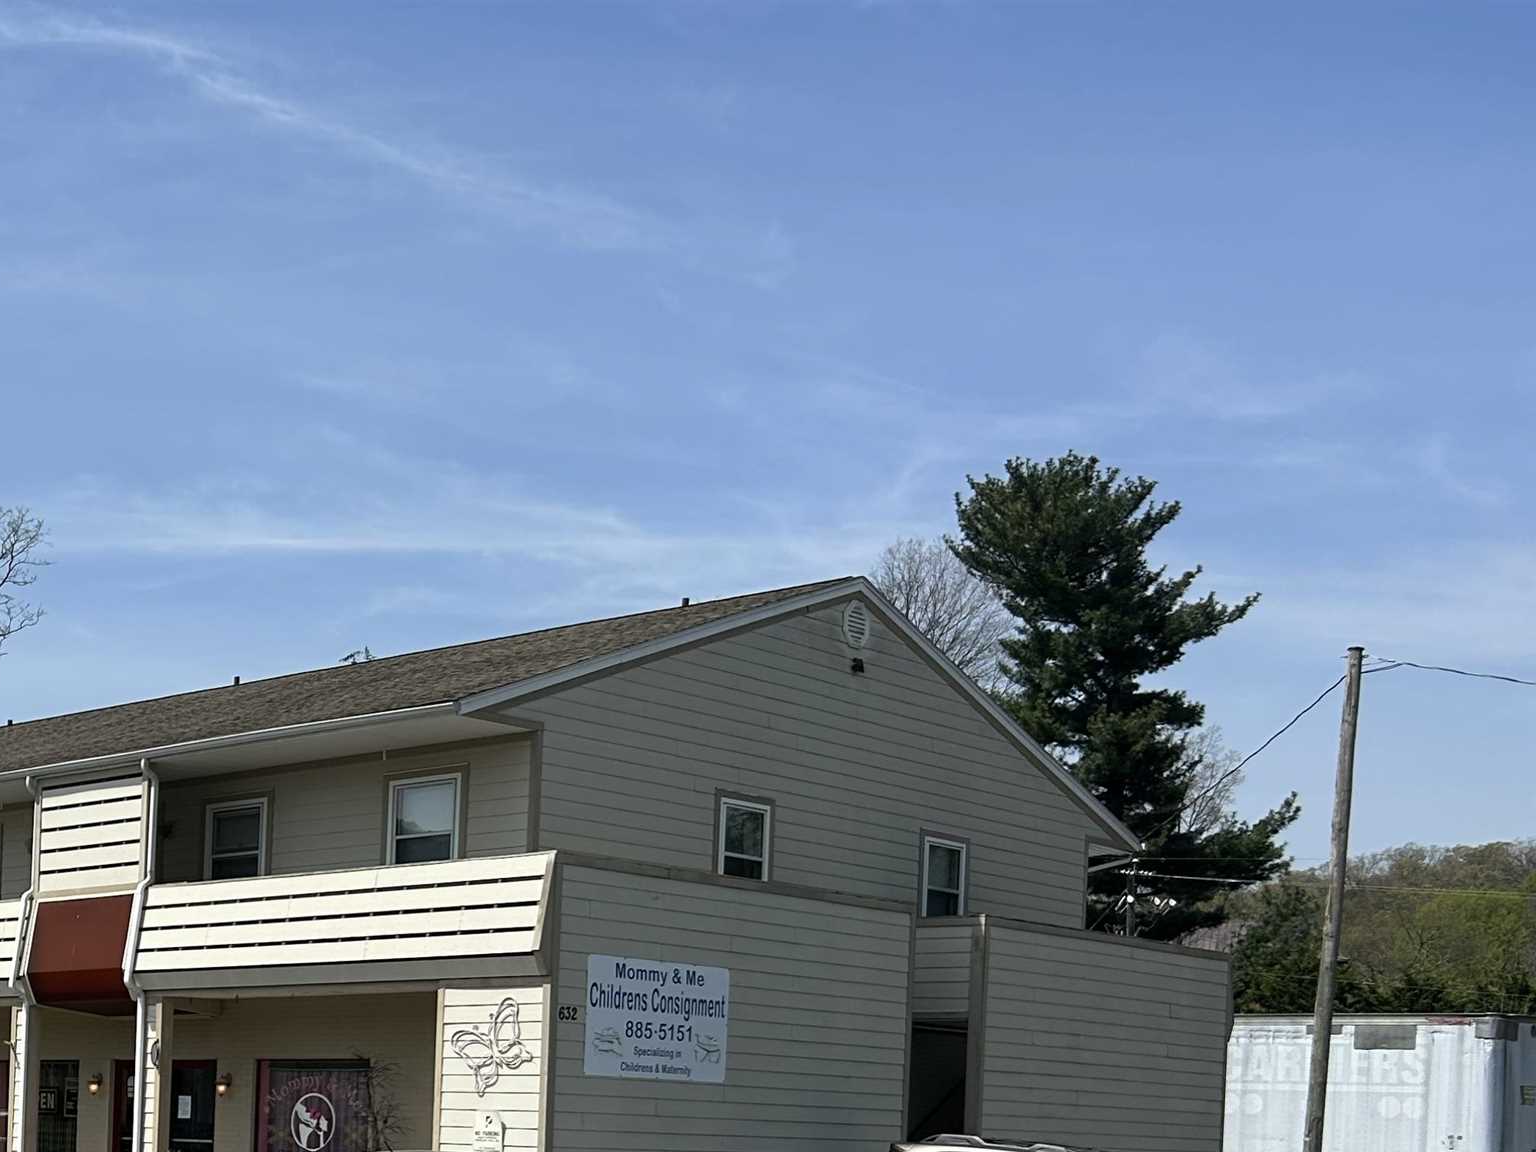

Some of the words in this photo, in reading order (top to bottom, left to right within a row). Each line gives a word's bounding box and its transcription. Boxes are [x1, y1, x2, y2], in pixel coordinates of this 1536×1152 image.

[615, 962, 668, 987] Mommy
[672, 968, 682, 985] &
[686, 970, 705, 987] Me
[589, 982, 648, 1012] Childrens
[651, 988, 725, 1021] Consignment
[558, 1006, 577, 1020] 632
[633, 1046, 674, 1060] Specializing
[620, 1061, 654, 1073] Childrens
[661, 1064, 691, 1077] Maternity
[40, 1092, 55, 1109] EN
